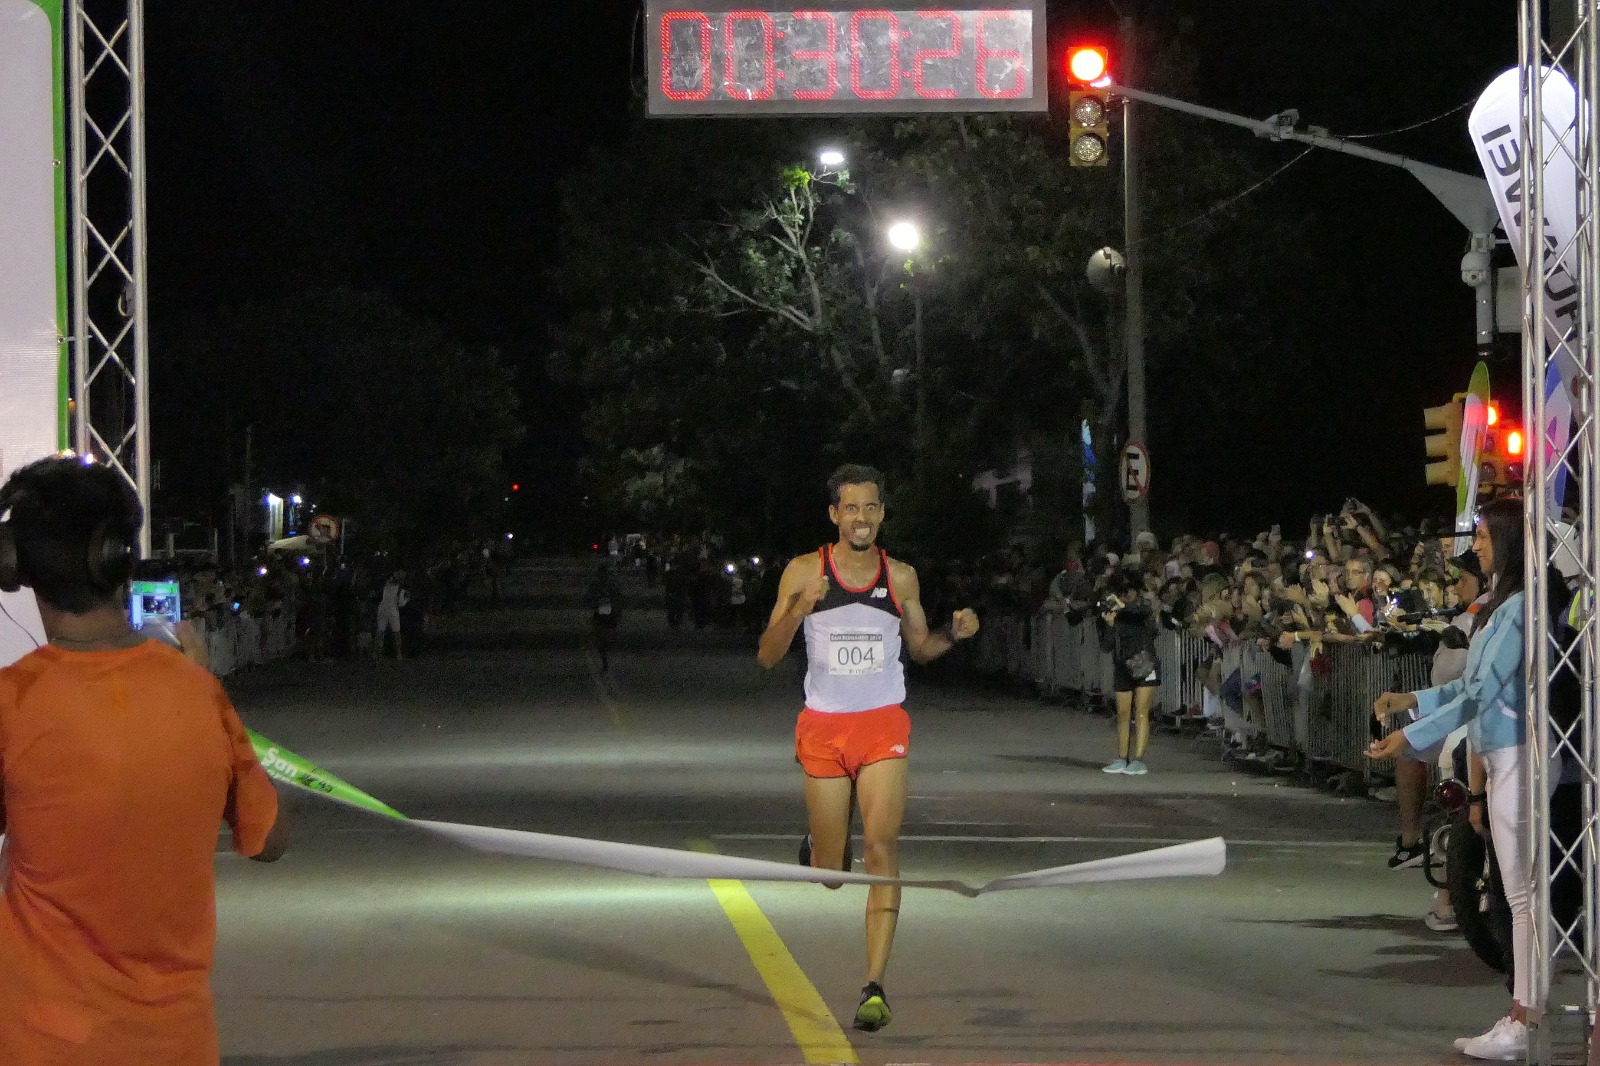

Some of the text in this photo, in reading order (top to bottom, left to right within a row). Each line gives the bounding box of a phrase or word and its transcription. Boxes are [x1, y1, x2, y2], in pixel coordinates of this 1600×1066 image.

[660, 10, 1025, 101] 00:30:26
[838, 646, 875, 665] 004
[261, 747, 298, 777] San
